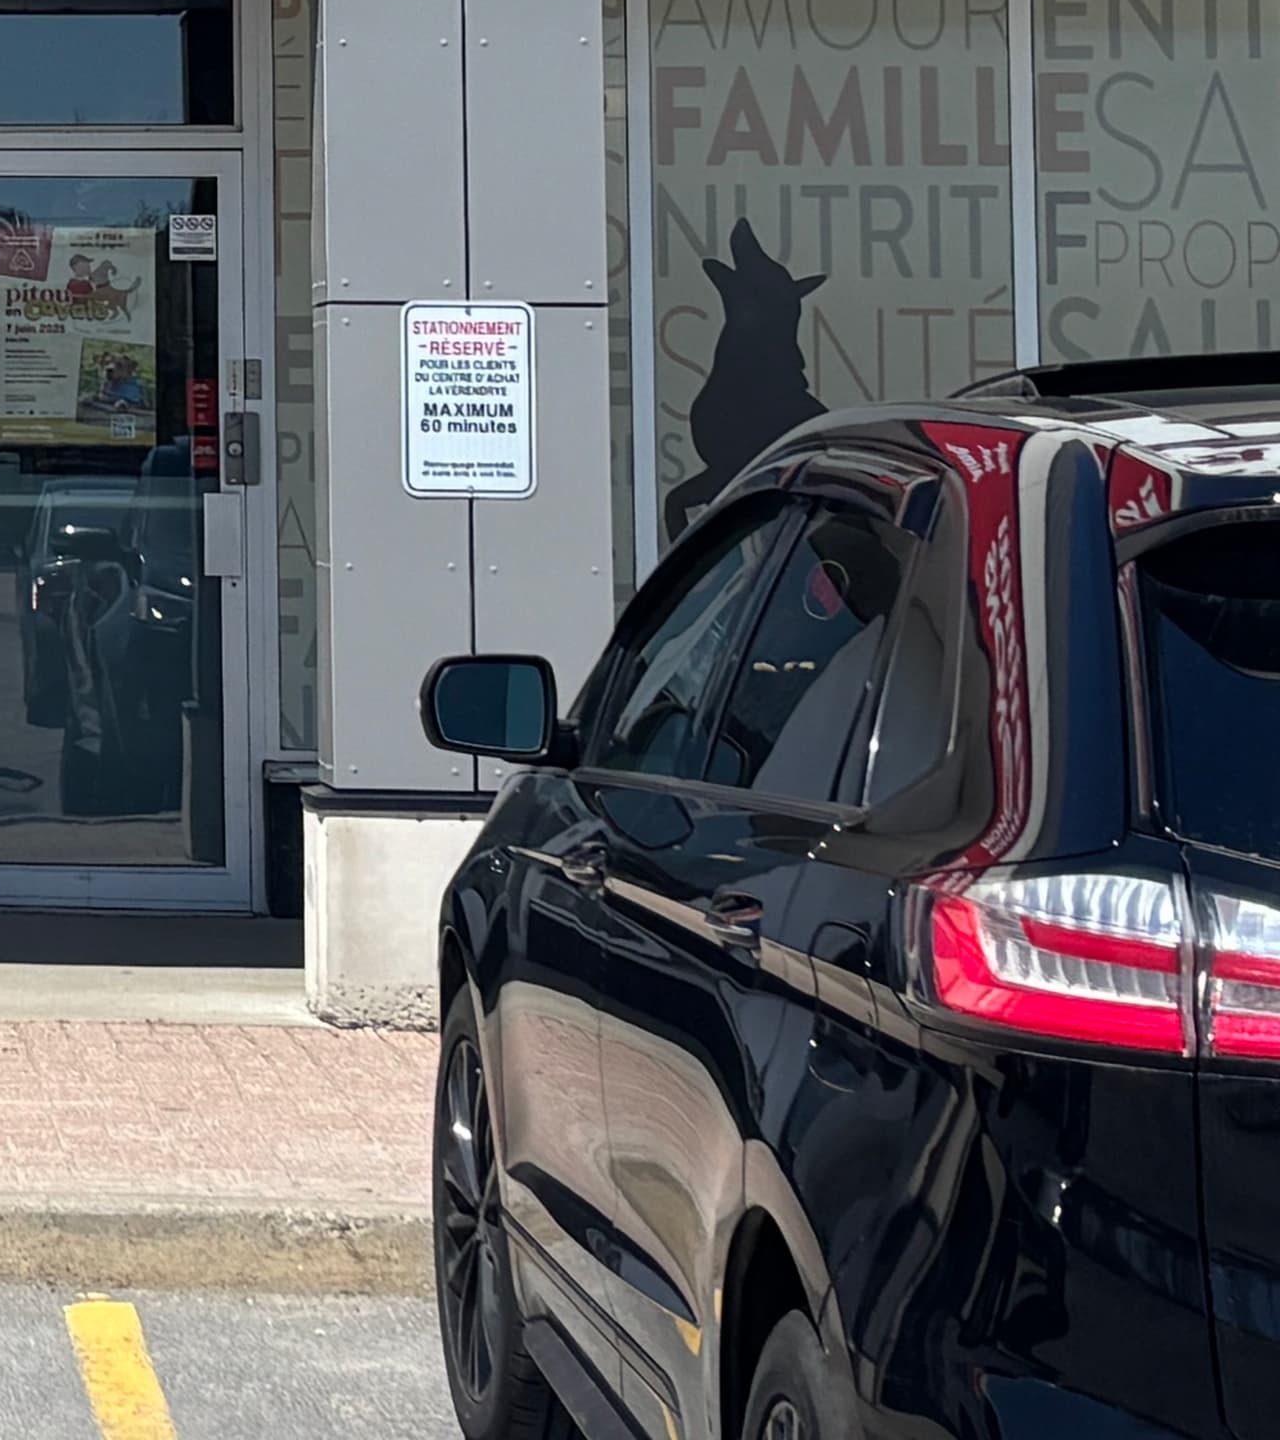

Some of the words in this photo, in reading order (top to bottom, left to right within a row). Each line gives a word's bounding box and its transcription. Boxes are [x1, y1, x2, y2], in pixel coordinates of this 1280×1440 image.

[654, 63, 1092, 173] FAMILLE
[5, 282, 70, 307] pitou
[413, 321, 522, 336] STATIONNEMENT
[419, 359, 449, 370] POUR
[451, 360, 471, 370] LES
[473, 360, 517, 371] CLIENTS
[414, 372, 430, 383] DU
[431, 372, 472, 383] CENTRE
[423, 402, 514, 418] MAXIMUM
[420, 419, 443, 433] 60
[447, 419, 518, 434] minutes
